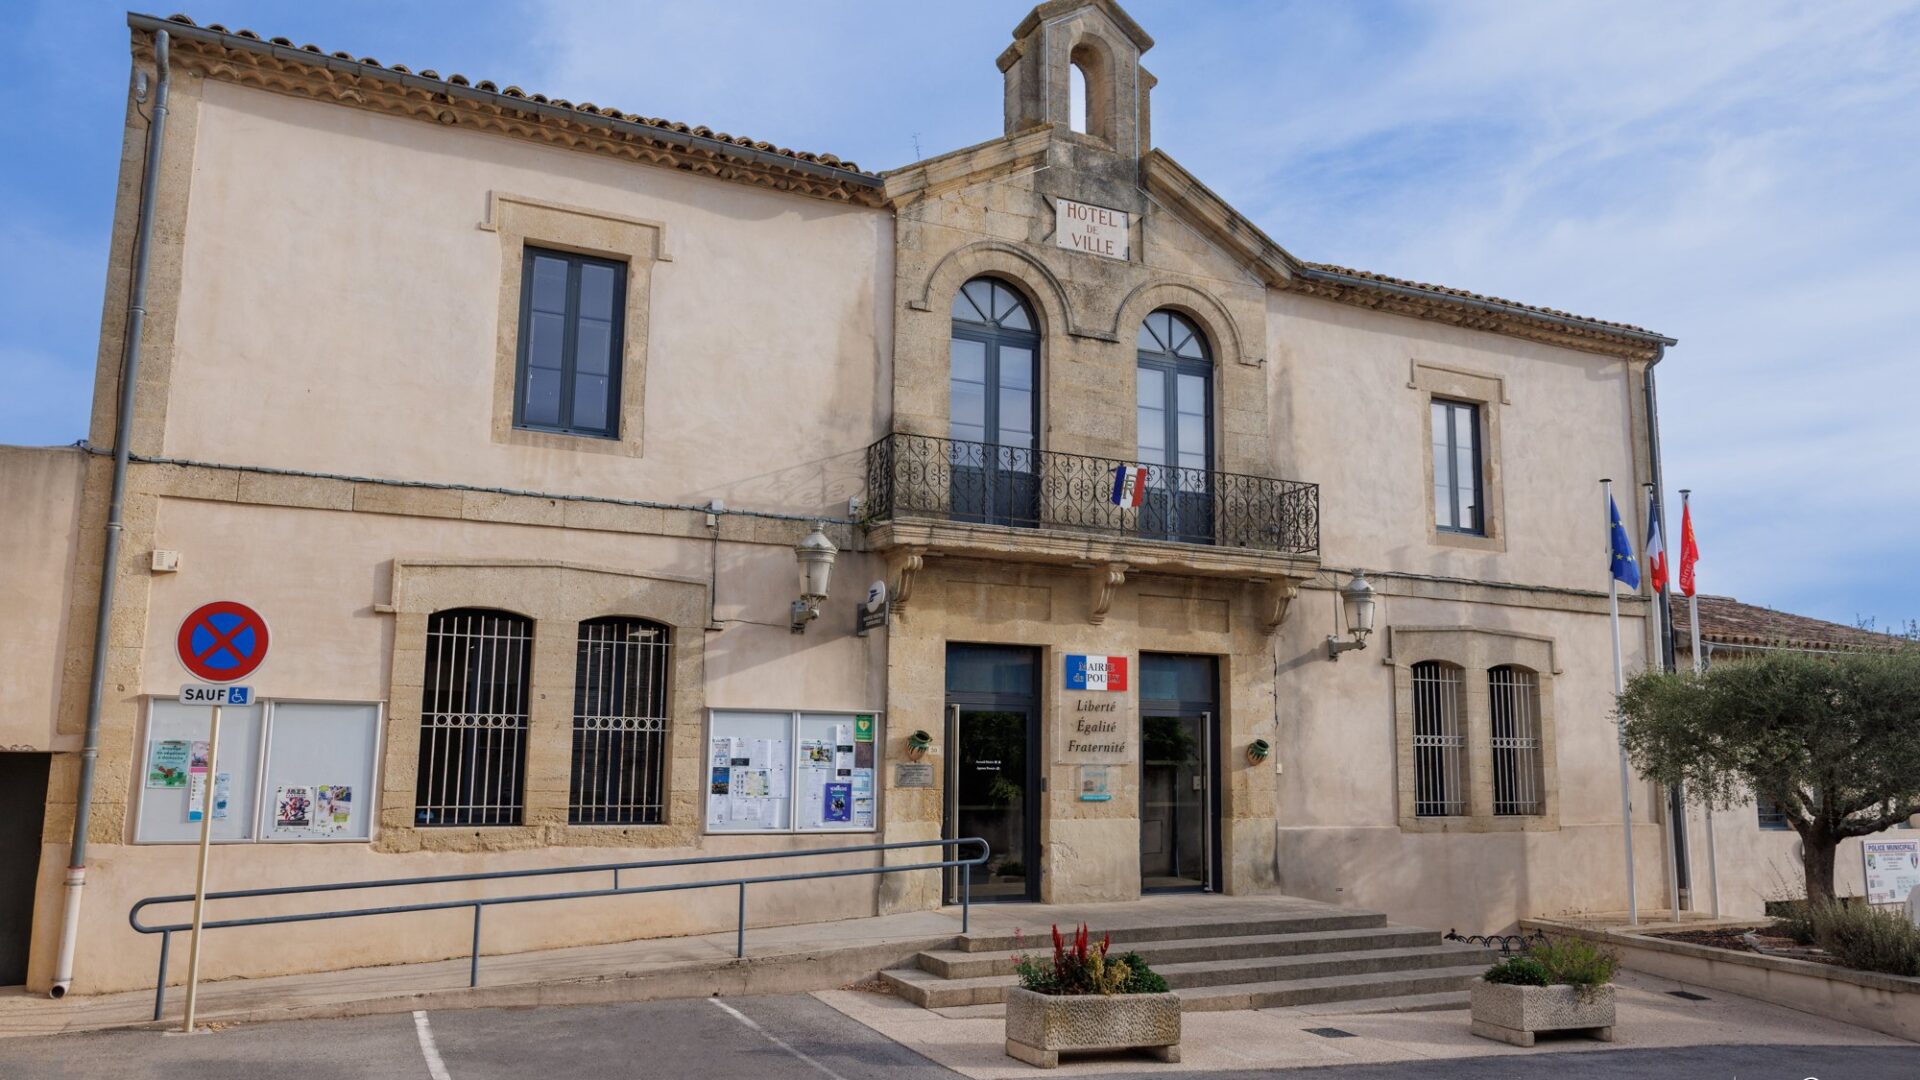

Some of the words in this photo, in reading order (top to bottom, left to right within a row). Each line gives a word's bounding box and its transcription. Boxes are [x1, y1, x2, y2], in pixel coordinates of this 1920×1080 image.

[1067, 203, 1118, 228] HOTEL
[1086, 224, 1099, 235] DE
[1072, 232, 1115, 256] VILLE
[1079, 662, 1115, 672] MAIRIE
[185, 688, 227, 702] SAUF
[1076, 699, 1116, 712] Liberté
[1076, 716, 1117, 736] Égalité
[1068, 740, 1126, 753] Fraternité
[1886, 843, 1916, 851] MUNICIPALE
